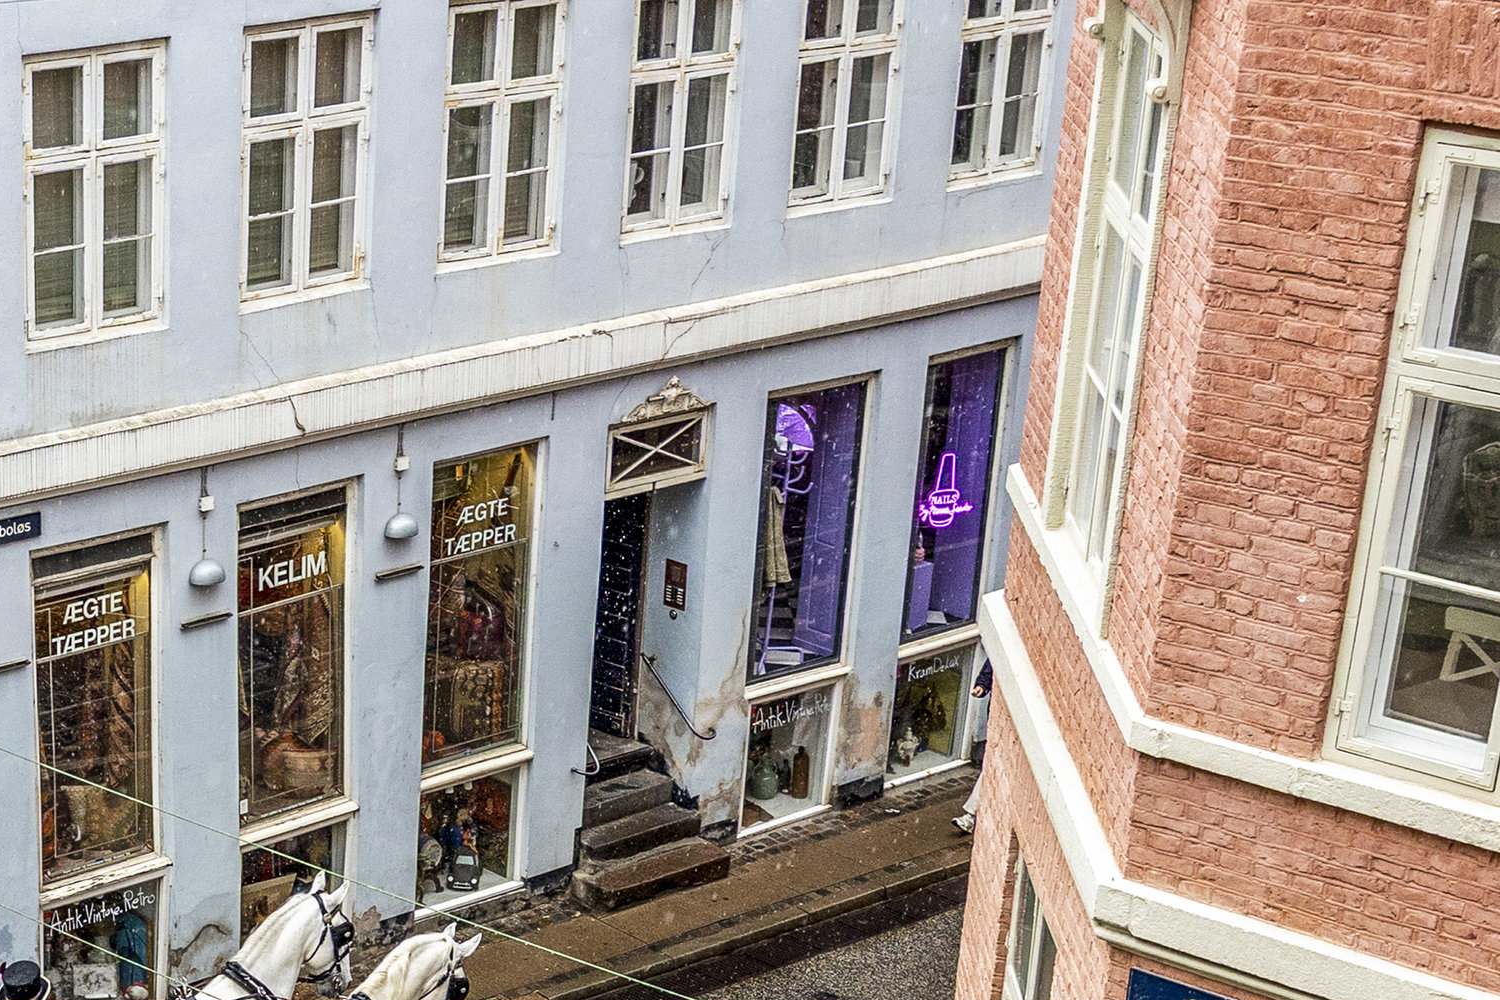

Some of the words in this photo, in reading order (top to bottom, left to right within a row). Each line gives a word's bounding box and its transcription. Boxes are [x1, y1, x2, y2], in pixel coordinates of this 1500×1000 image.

[456, 497, 509, 527] ÆGTE
[931, 494, 958, 505] NAILS
[444, 523, 517, 556] TÆPPER
[258, 550, 326, 592] KELIM
[62, 591, 124, 625] ÆGTE
[51, 618, 136, 656] TÆPPER
